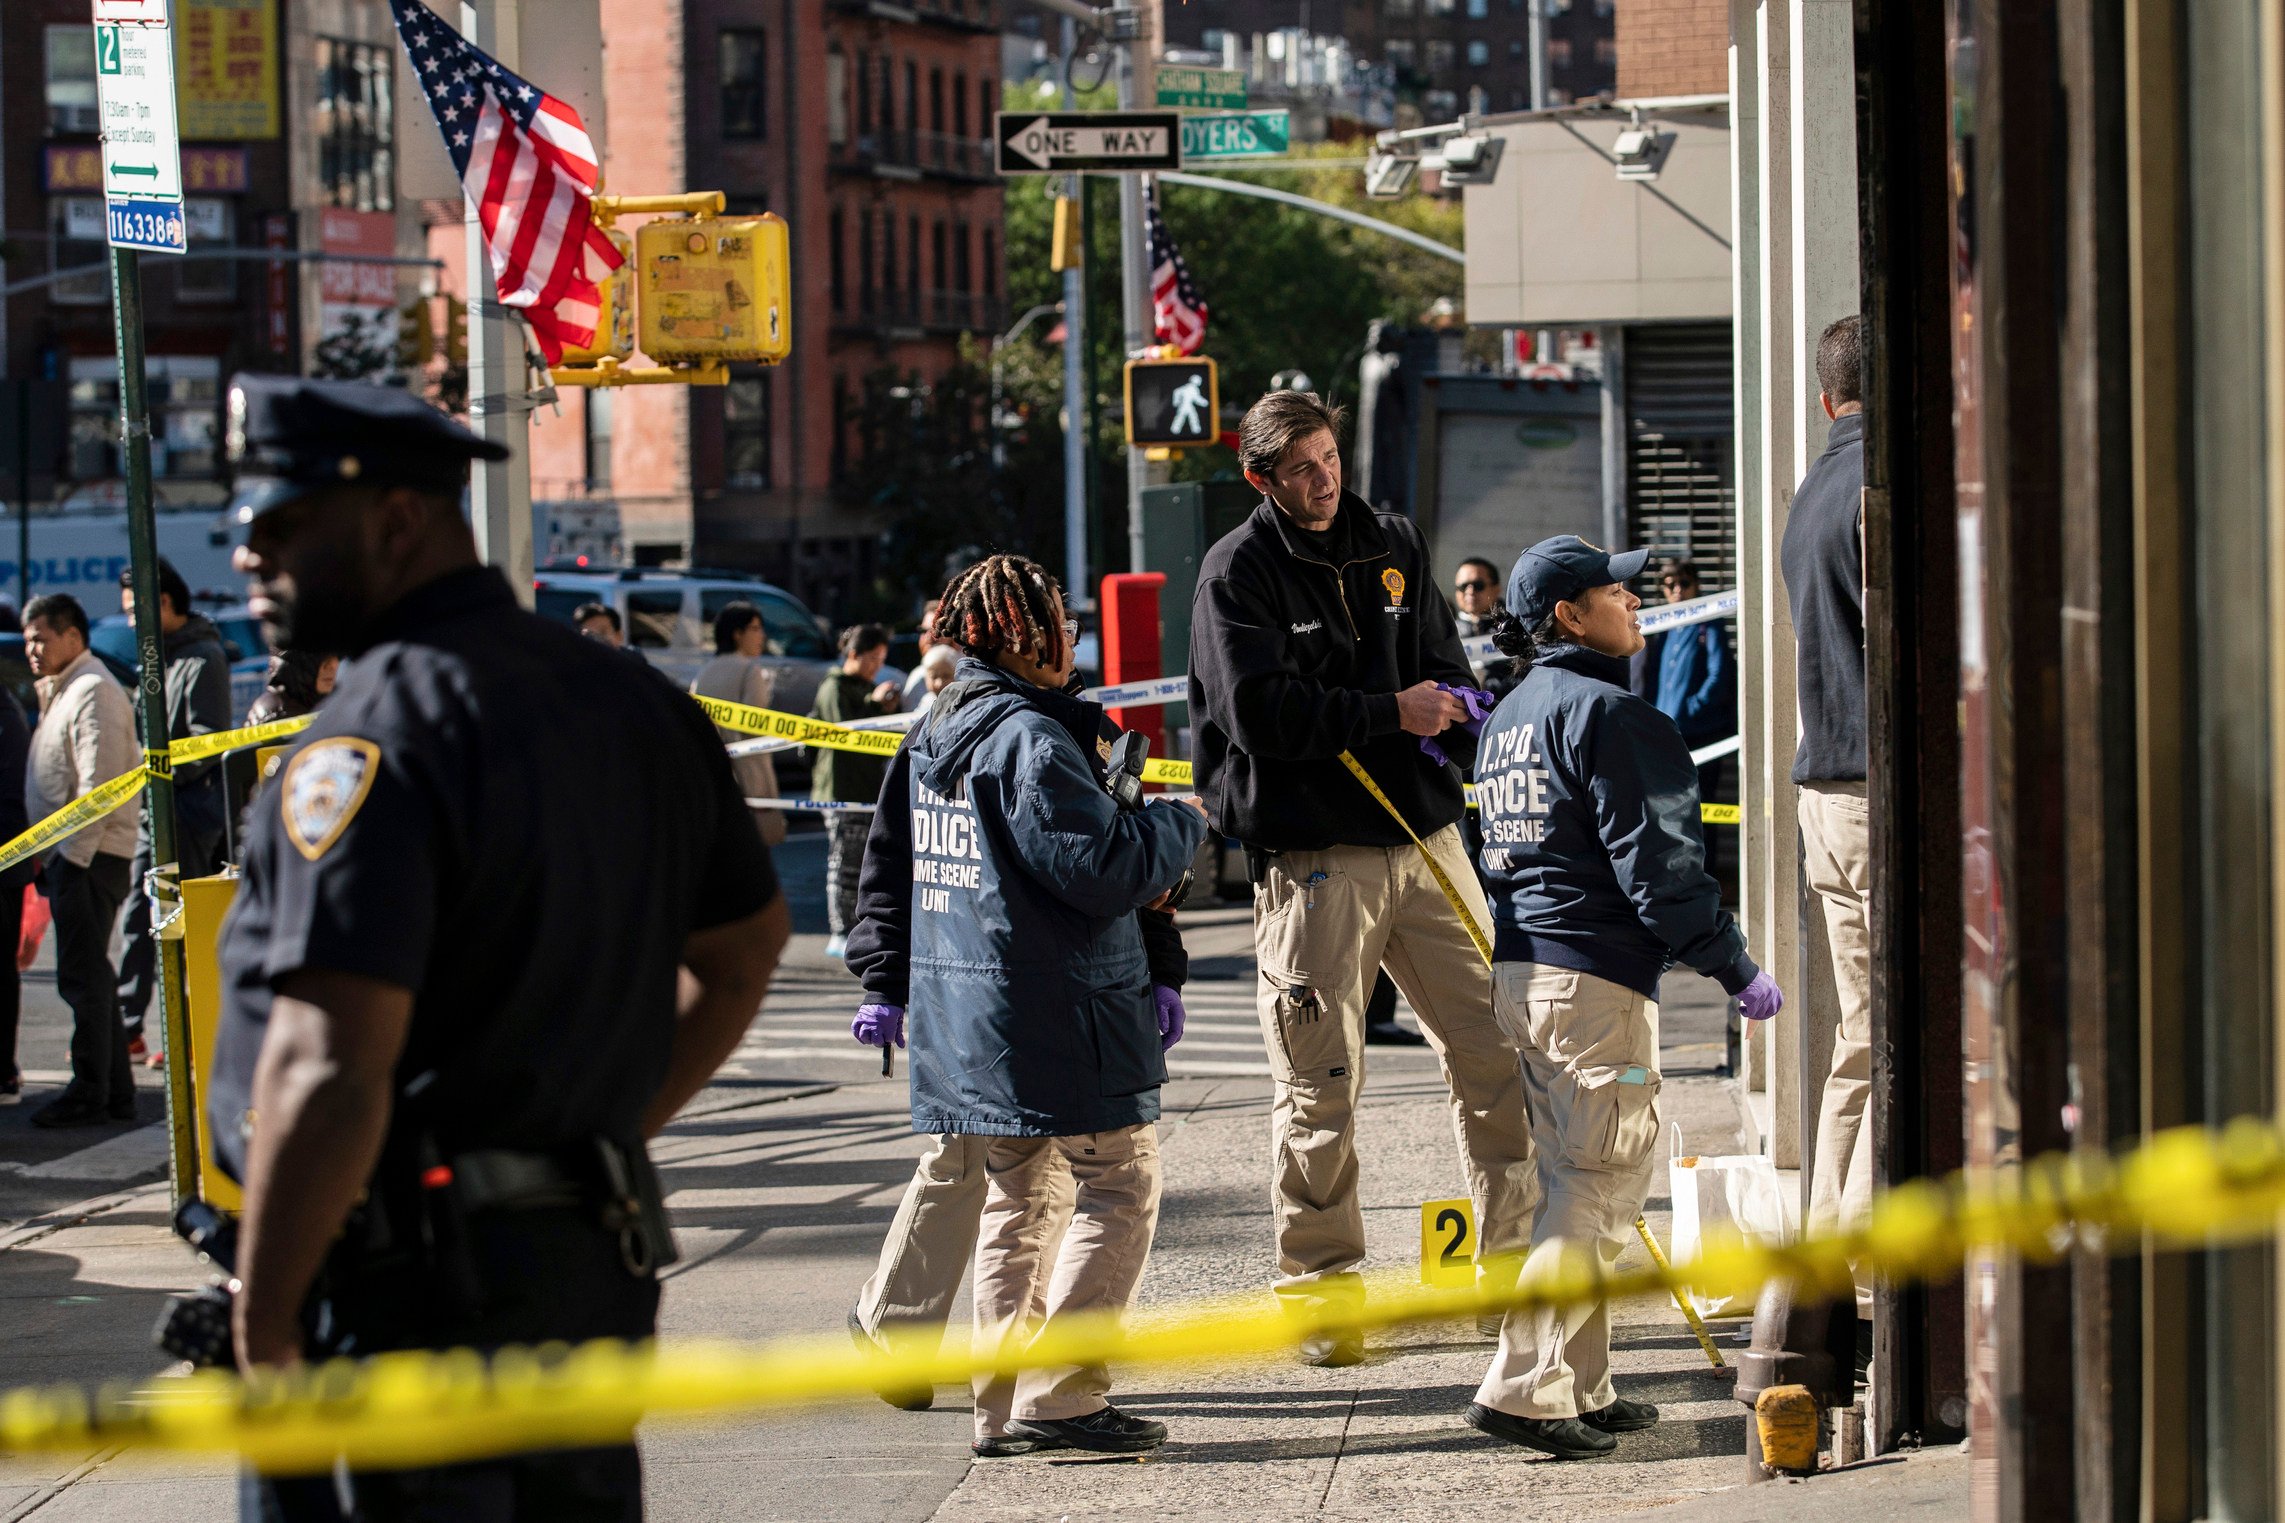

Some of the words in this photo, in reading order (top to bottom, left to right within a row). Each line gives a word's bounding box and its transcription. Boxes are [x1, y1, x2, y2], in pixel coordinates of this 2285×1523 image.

[102, 27, 116, 70] 2
[124, 64, 146, 79] parking
[107, 126, 129, 145] Except
[131, 126, 156, 147] Sunday
[1025, 131, 1076, 154] ONE
[1102, 131, 1155, 154] WAY
[110, 210, 165, 244] 116338
[1493, 819, 1546, 844] SCENE
[940, 862, 982, 890] SCENE
[921, 888, 951, 914] UNIT
[1436, 1208, 1468, 1269] 2
